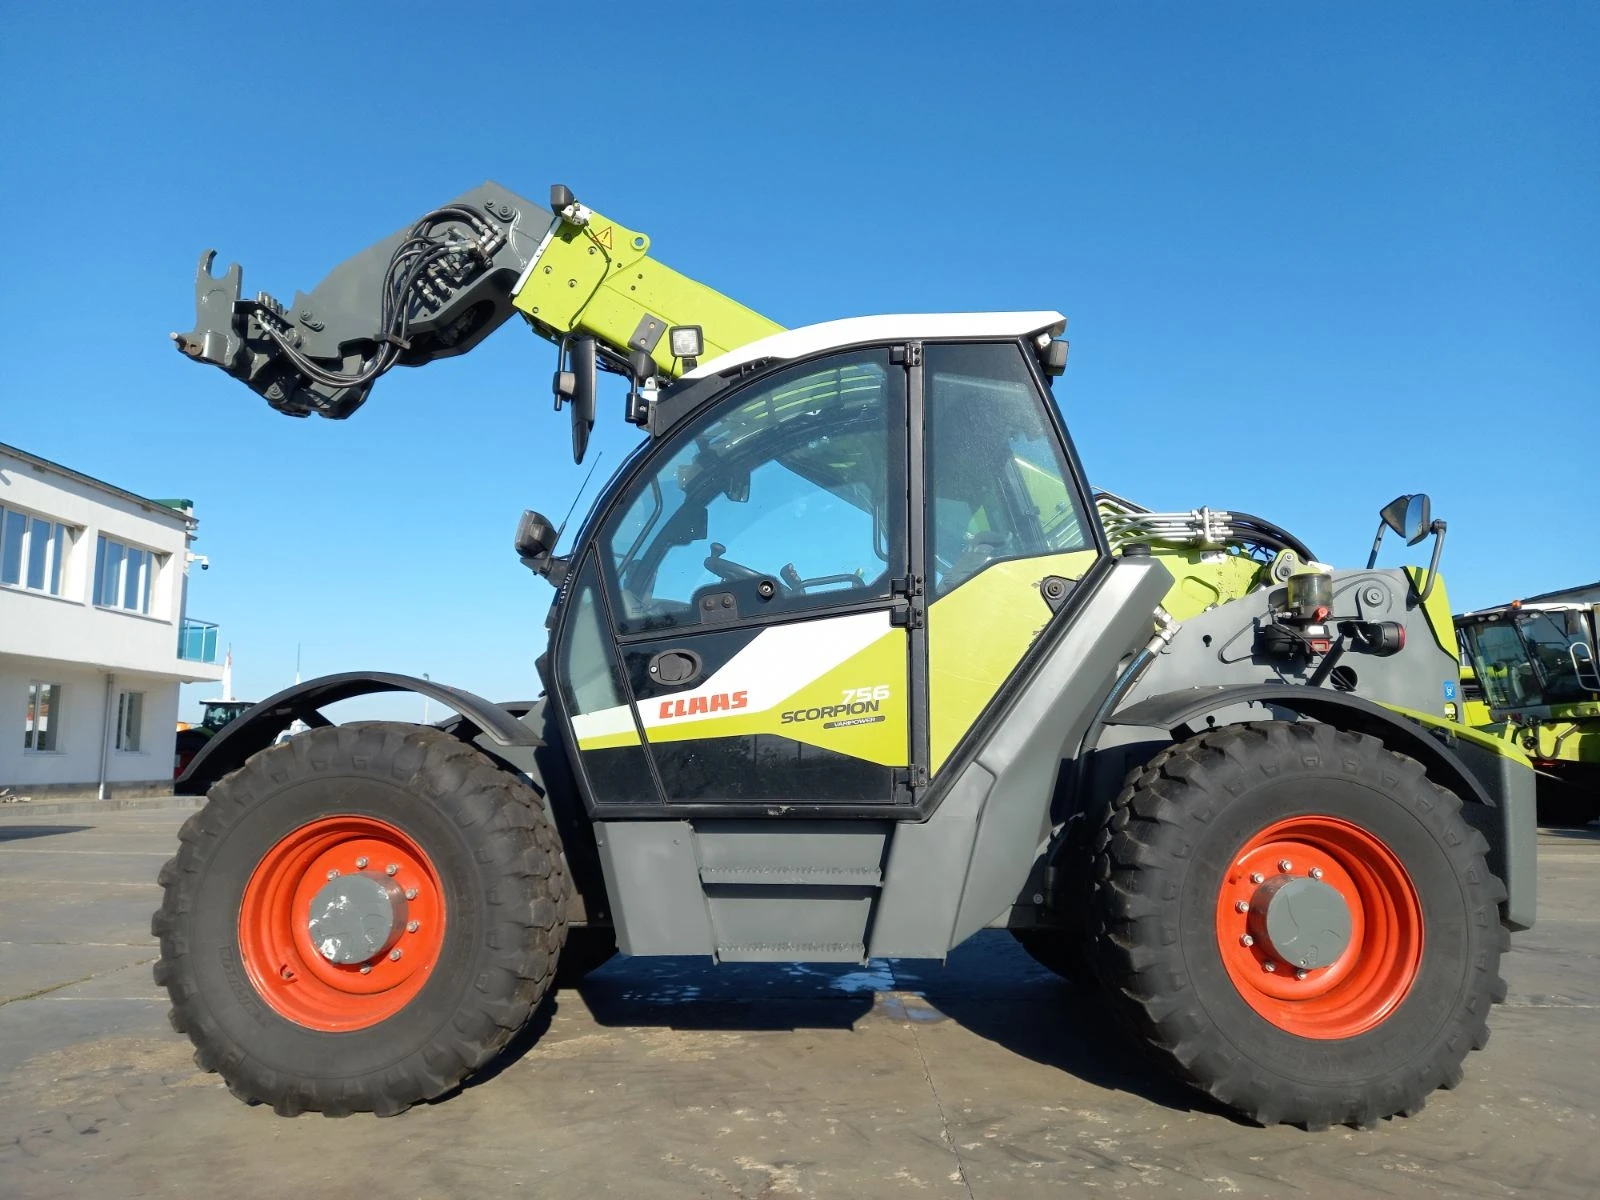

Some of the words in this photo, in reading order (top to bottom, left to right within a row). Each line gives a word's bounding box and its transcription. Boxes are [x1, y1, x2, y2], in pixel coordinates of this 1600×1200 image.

[659, 691, 748, 719] CLAAS
[841, 685, 890, 705] 756
[781, 700, 879, 724] SCORPION
